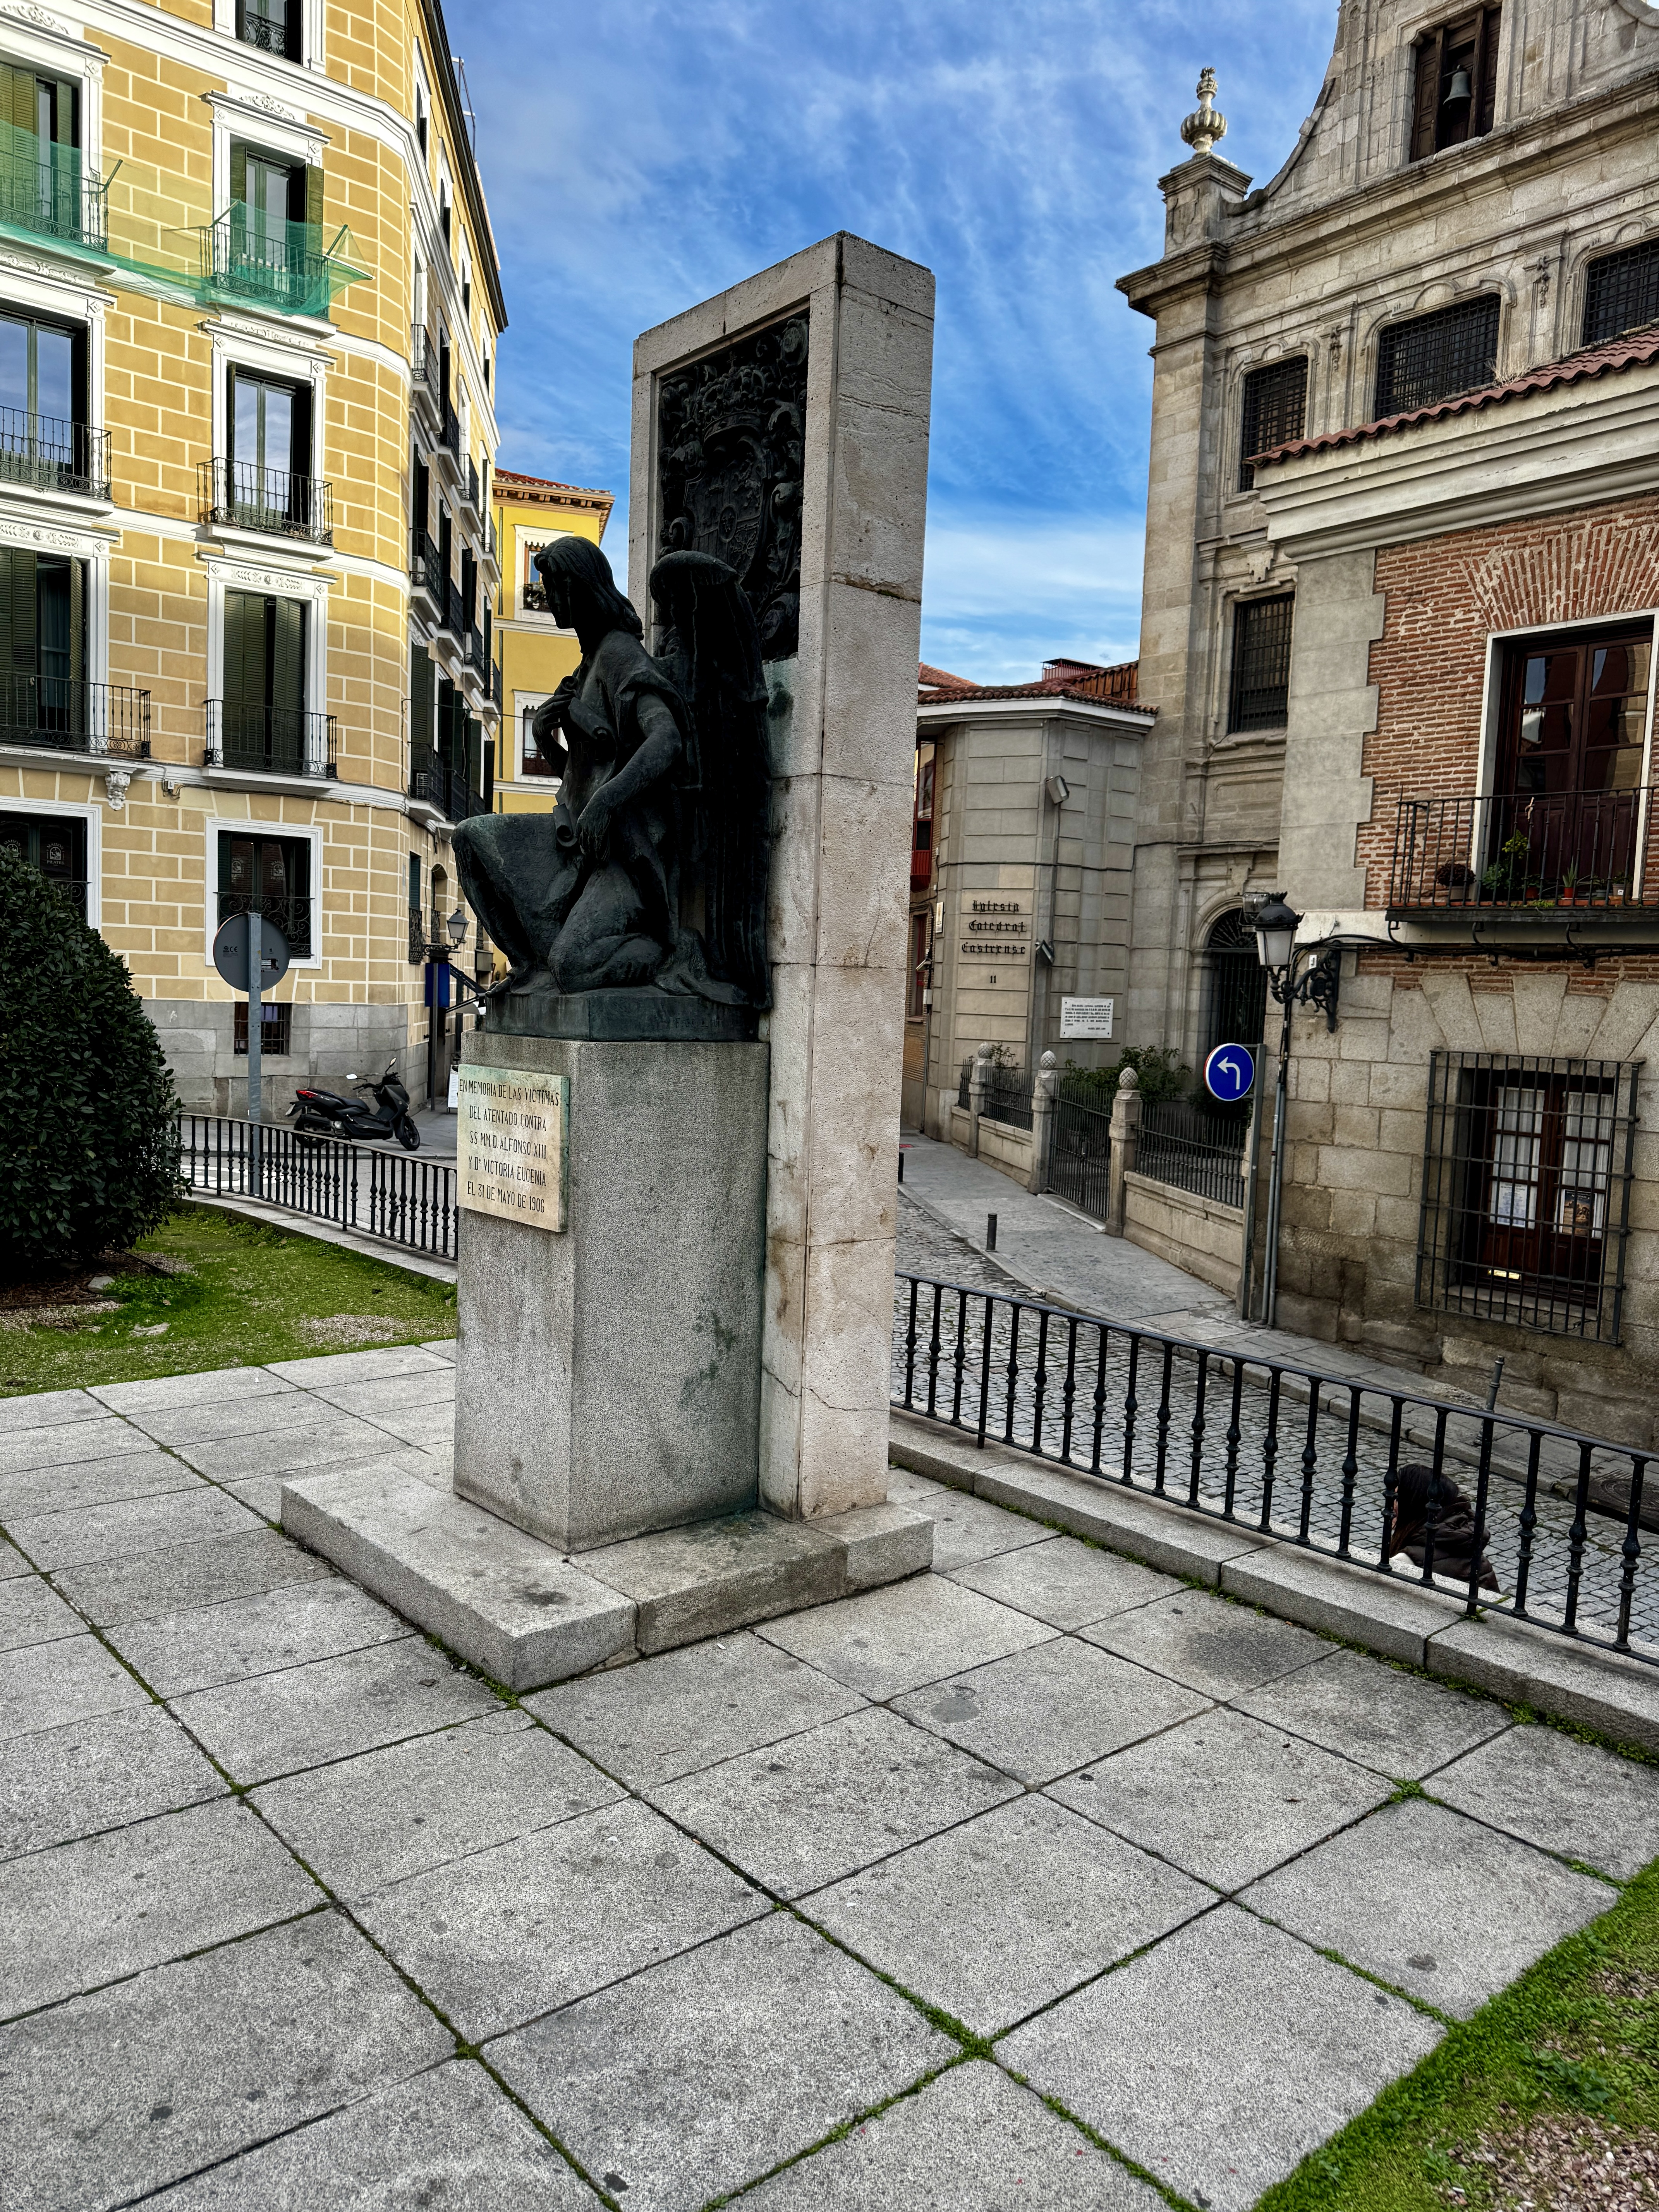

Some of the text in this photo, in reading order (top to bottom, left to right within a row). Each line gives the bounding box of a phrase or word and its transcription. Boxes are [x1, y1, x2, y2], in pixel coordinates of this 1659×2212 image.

[972, 900, 1019, 913] Iglesia
[969, 920, 1027, 933] Catedral
[962, 942, 1026, 954] Castrense
[460, 1079, 467, 1092] EN
[469, 1080, 496, 1097] MEMORIA
[498, 1084, 506, 1098] DE
[508, 1085, 521, 1100] LAS
[525, 1087, 559, 1106] VICTIMAS
[470, 1105, 546, 1131] DEL ATENTADO CONTRA
[500, 1137, 531, 1155] ALFONSO
[534, 1143, 546, 1159] XIII
[469, 1155, 472, 1169] Y
[484, 1158, 514, 1179] VICTORIA
[517, 1166, 546, 1187] EUGENIA
[468, 1181, 544, 1213] EL 31 DE MAYO DE 1906
